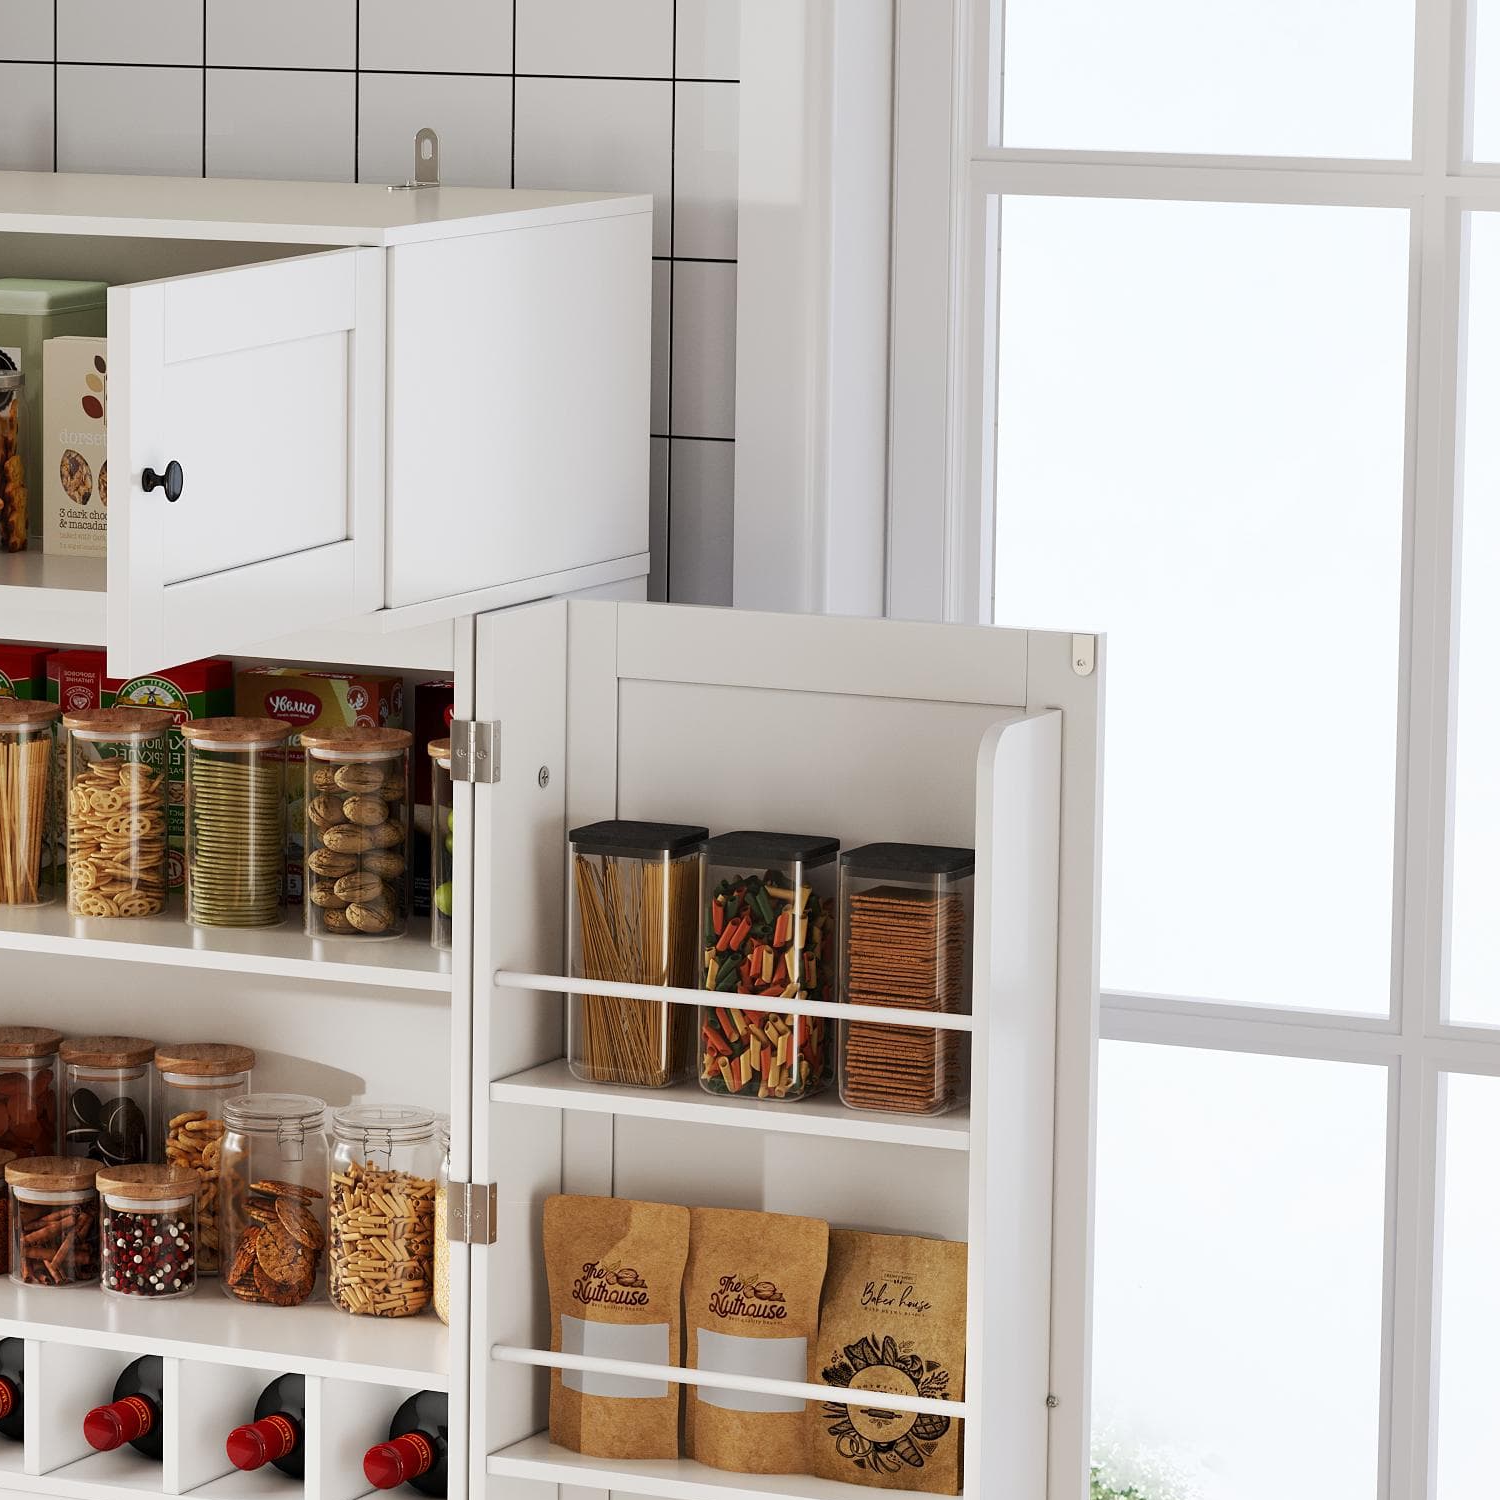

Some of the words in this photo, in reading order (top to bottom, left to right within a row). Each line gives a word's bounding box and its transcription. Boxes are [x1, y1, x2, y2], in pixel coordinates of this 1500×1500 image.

[59, 508, 66, 518] 3
[66, 508, 88, 519] dark
[59, 518, 67, 529] &
[269, 695, 316, 716] Увелка
[582, 1261, 608, 1282] The
[572, 1278, 650, 1306] Nuthouse
[719, 1274, 745, 1295] The
[708, 1292, 788, 1319] Nuthouse
[860, 1281, 896, 1306] Baker
[899, 1286, 932, 1312] house
